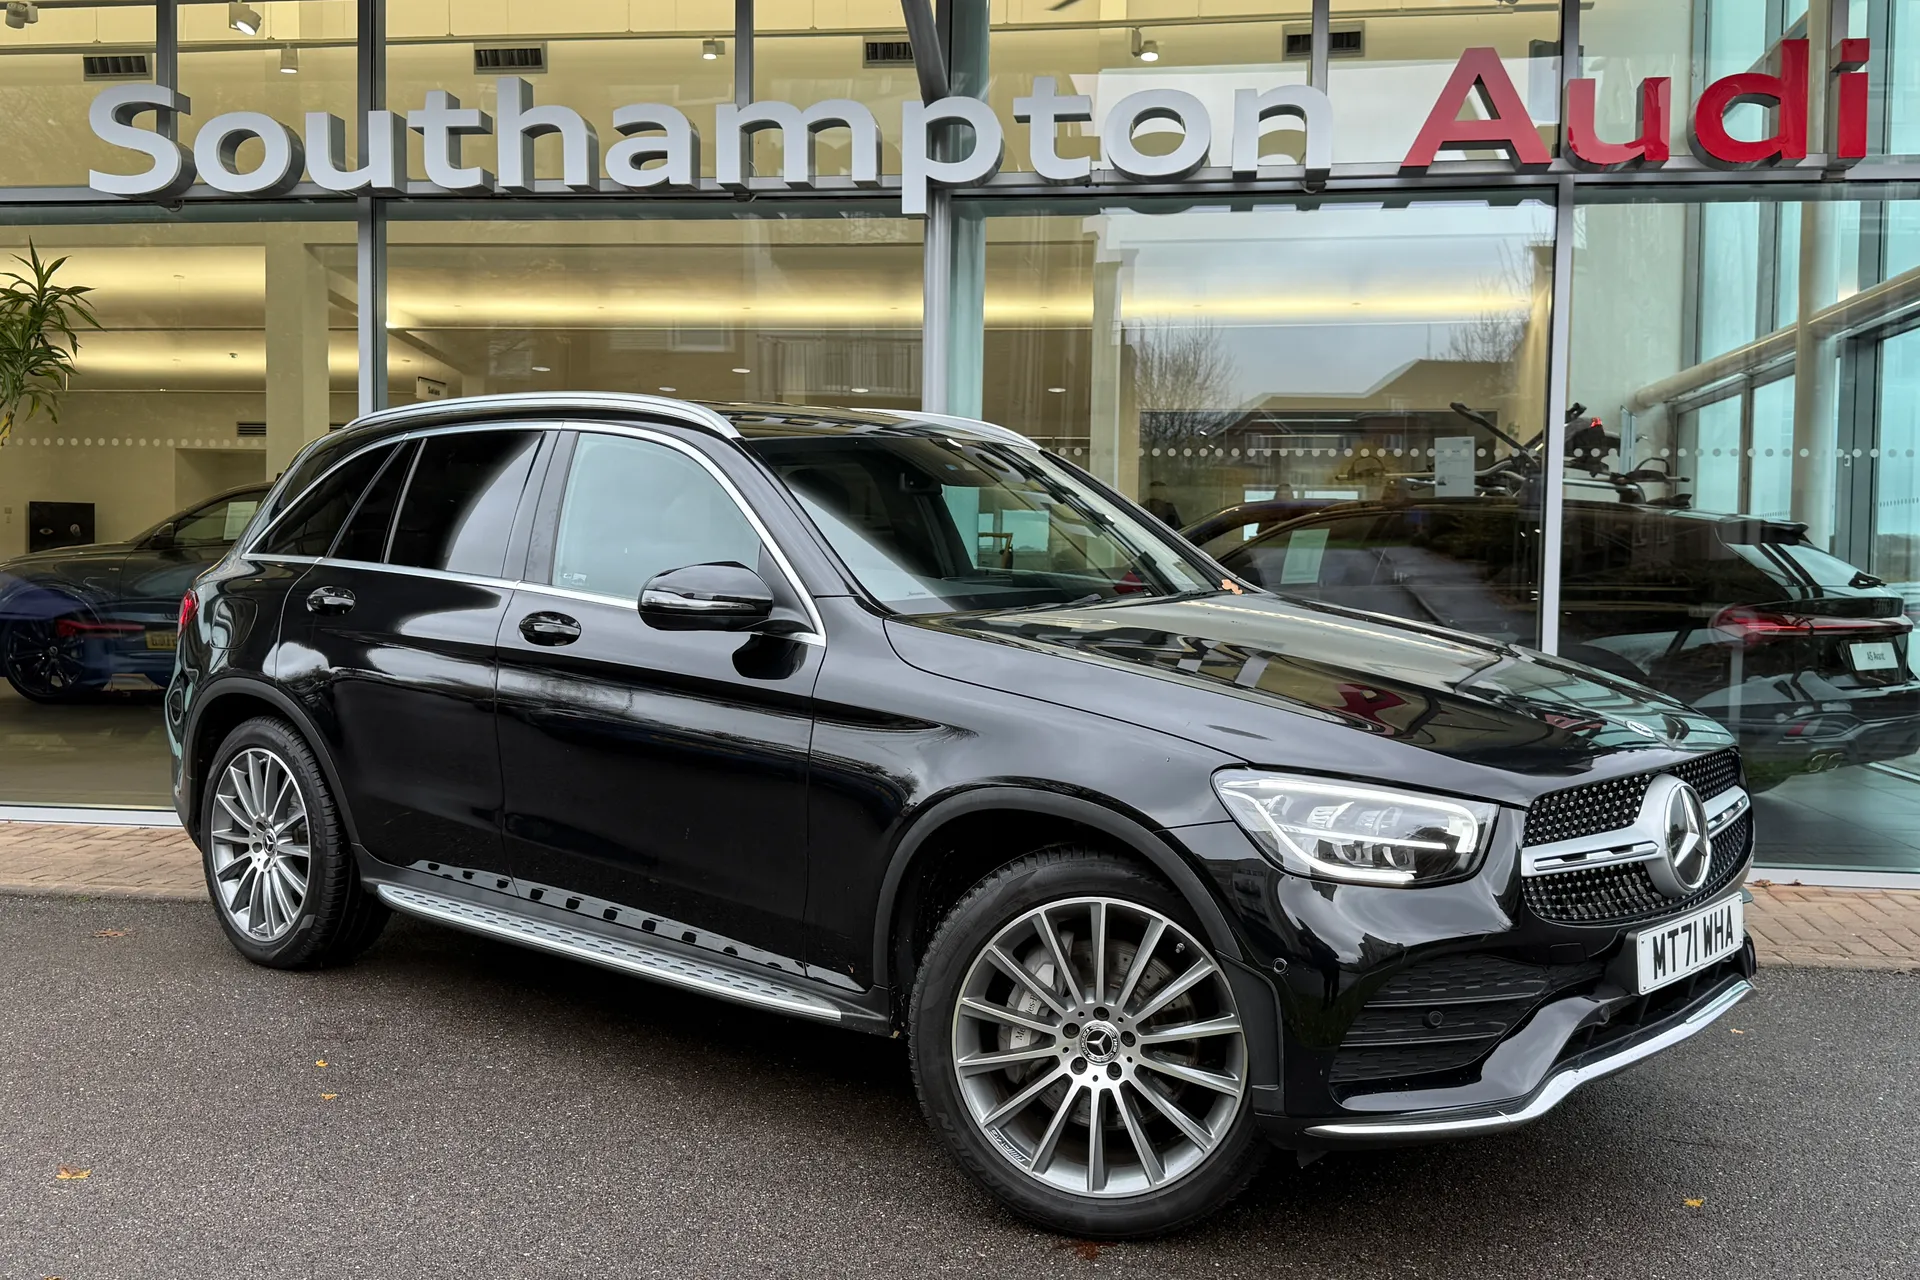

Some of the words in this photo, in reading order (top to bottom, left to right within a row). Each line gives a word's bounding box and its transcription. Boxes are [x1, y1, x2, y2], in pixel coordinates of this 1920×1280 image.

[88, 76, 1333, 218] Southampton
[1399, 38, 1870, 175] Audi
[1652, 920, 1698, 980] MT71
[1702, 905, 1734, 959] WHA
